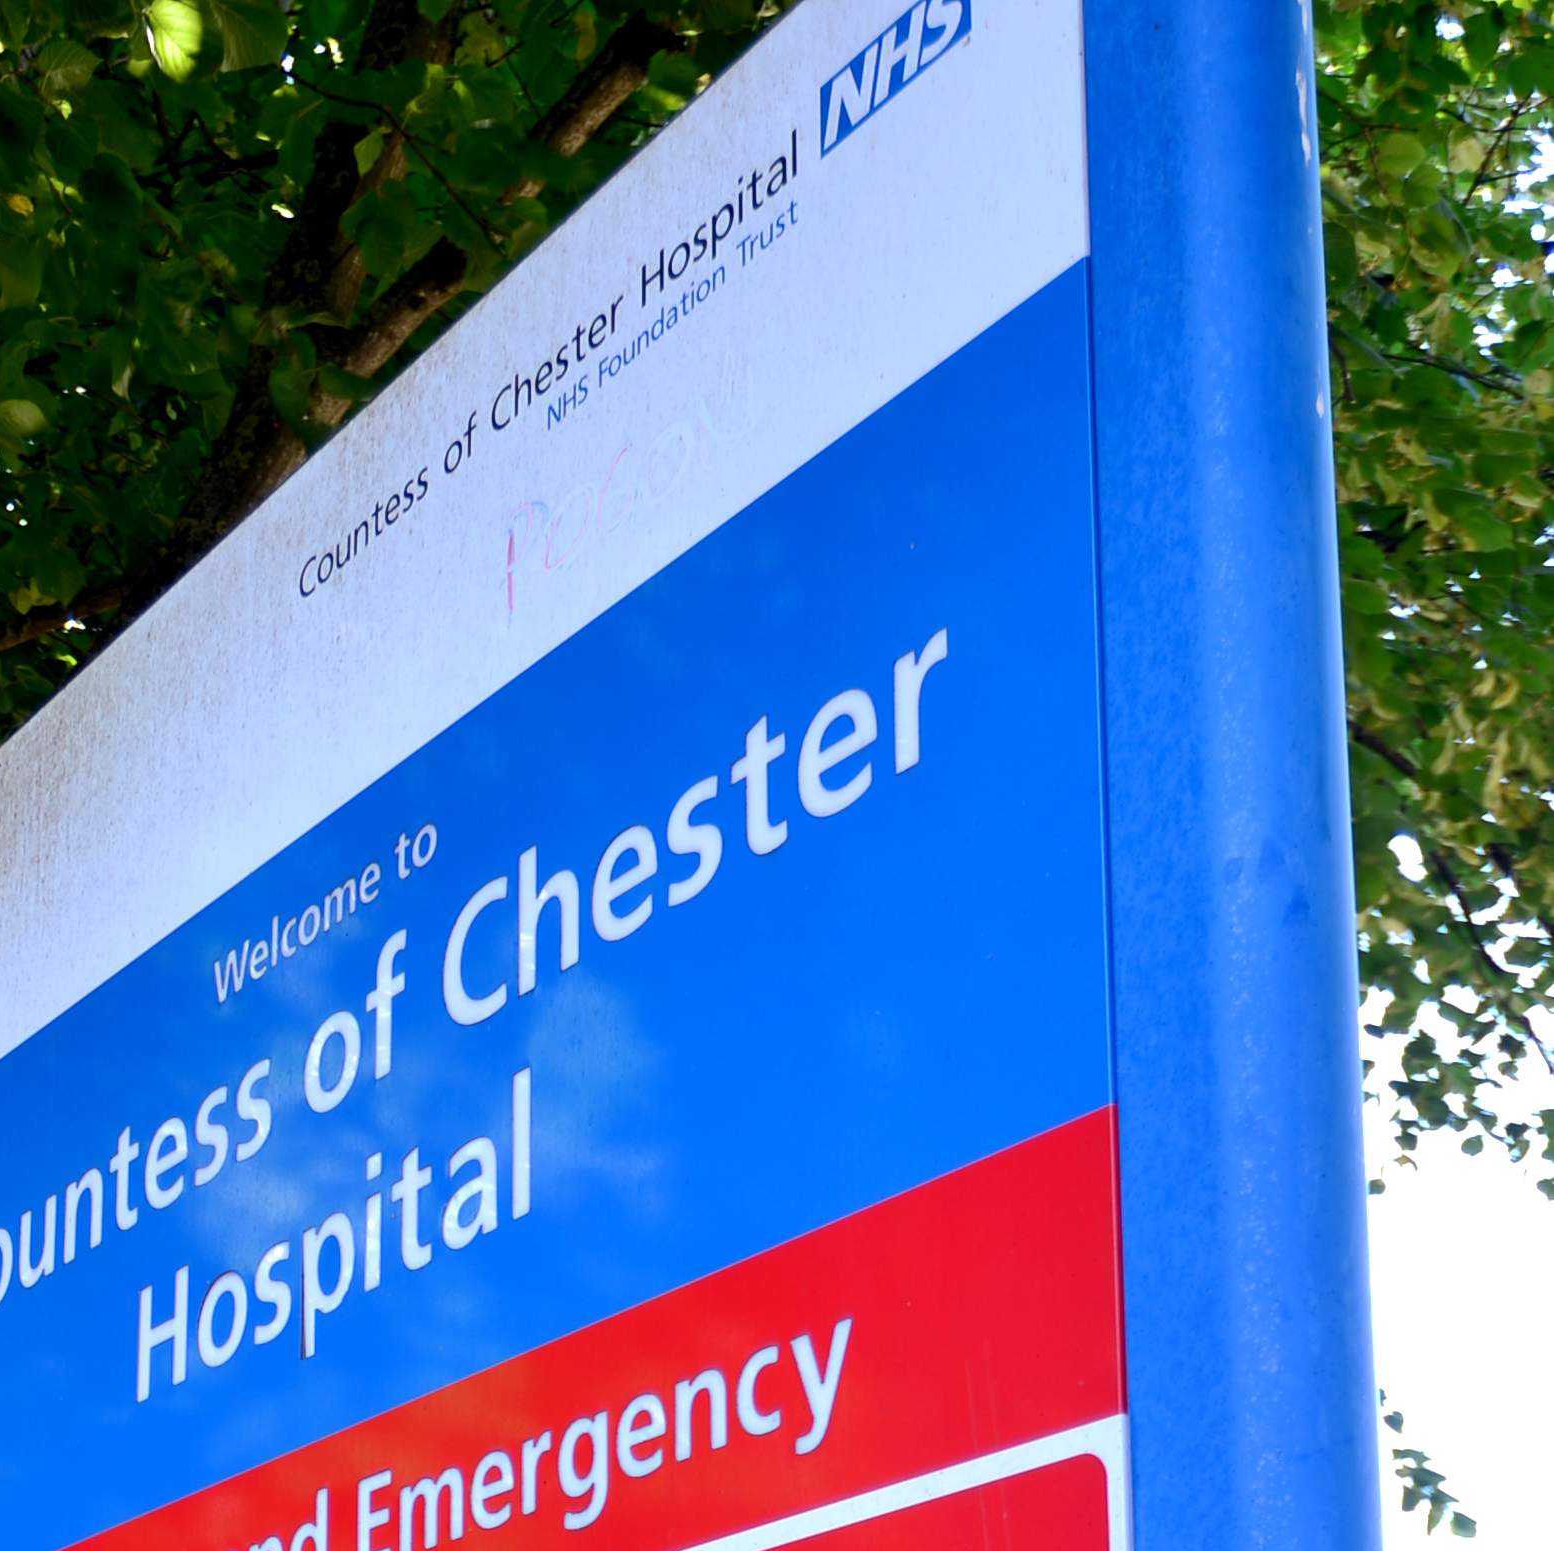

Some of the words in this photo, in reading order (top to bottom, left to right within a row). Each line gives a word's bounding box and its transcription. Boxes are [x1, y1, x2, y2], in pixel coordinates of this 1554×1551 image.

[823, 0, 963, 150] NHS
[299, 467, 428, 598] Countess
[443, 410, 477, 474] of
[491, 295, 624, 431] Chester
[641, 128, 798, 308] Hospital
[547, 374, 589, 431] NHS
[598, 265, 726, 388] Foundation
[735, 200, 799, 267] Trust
[214, 863, 381, 1003] Welcome
[394, 824, 437, 879] to
[304, 929, 407, 1113] of
[443, 629, 948, 1025] Chester
[136, 1067, 531, 1403] Hospital
